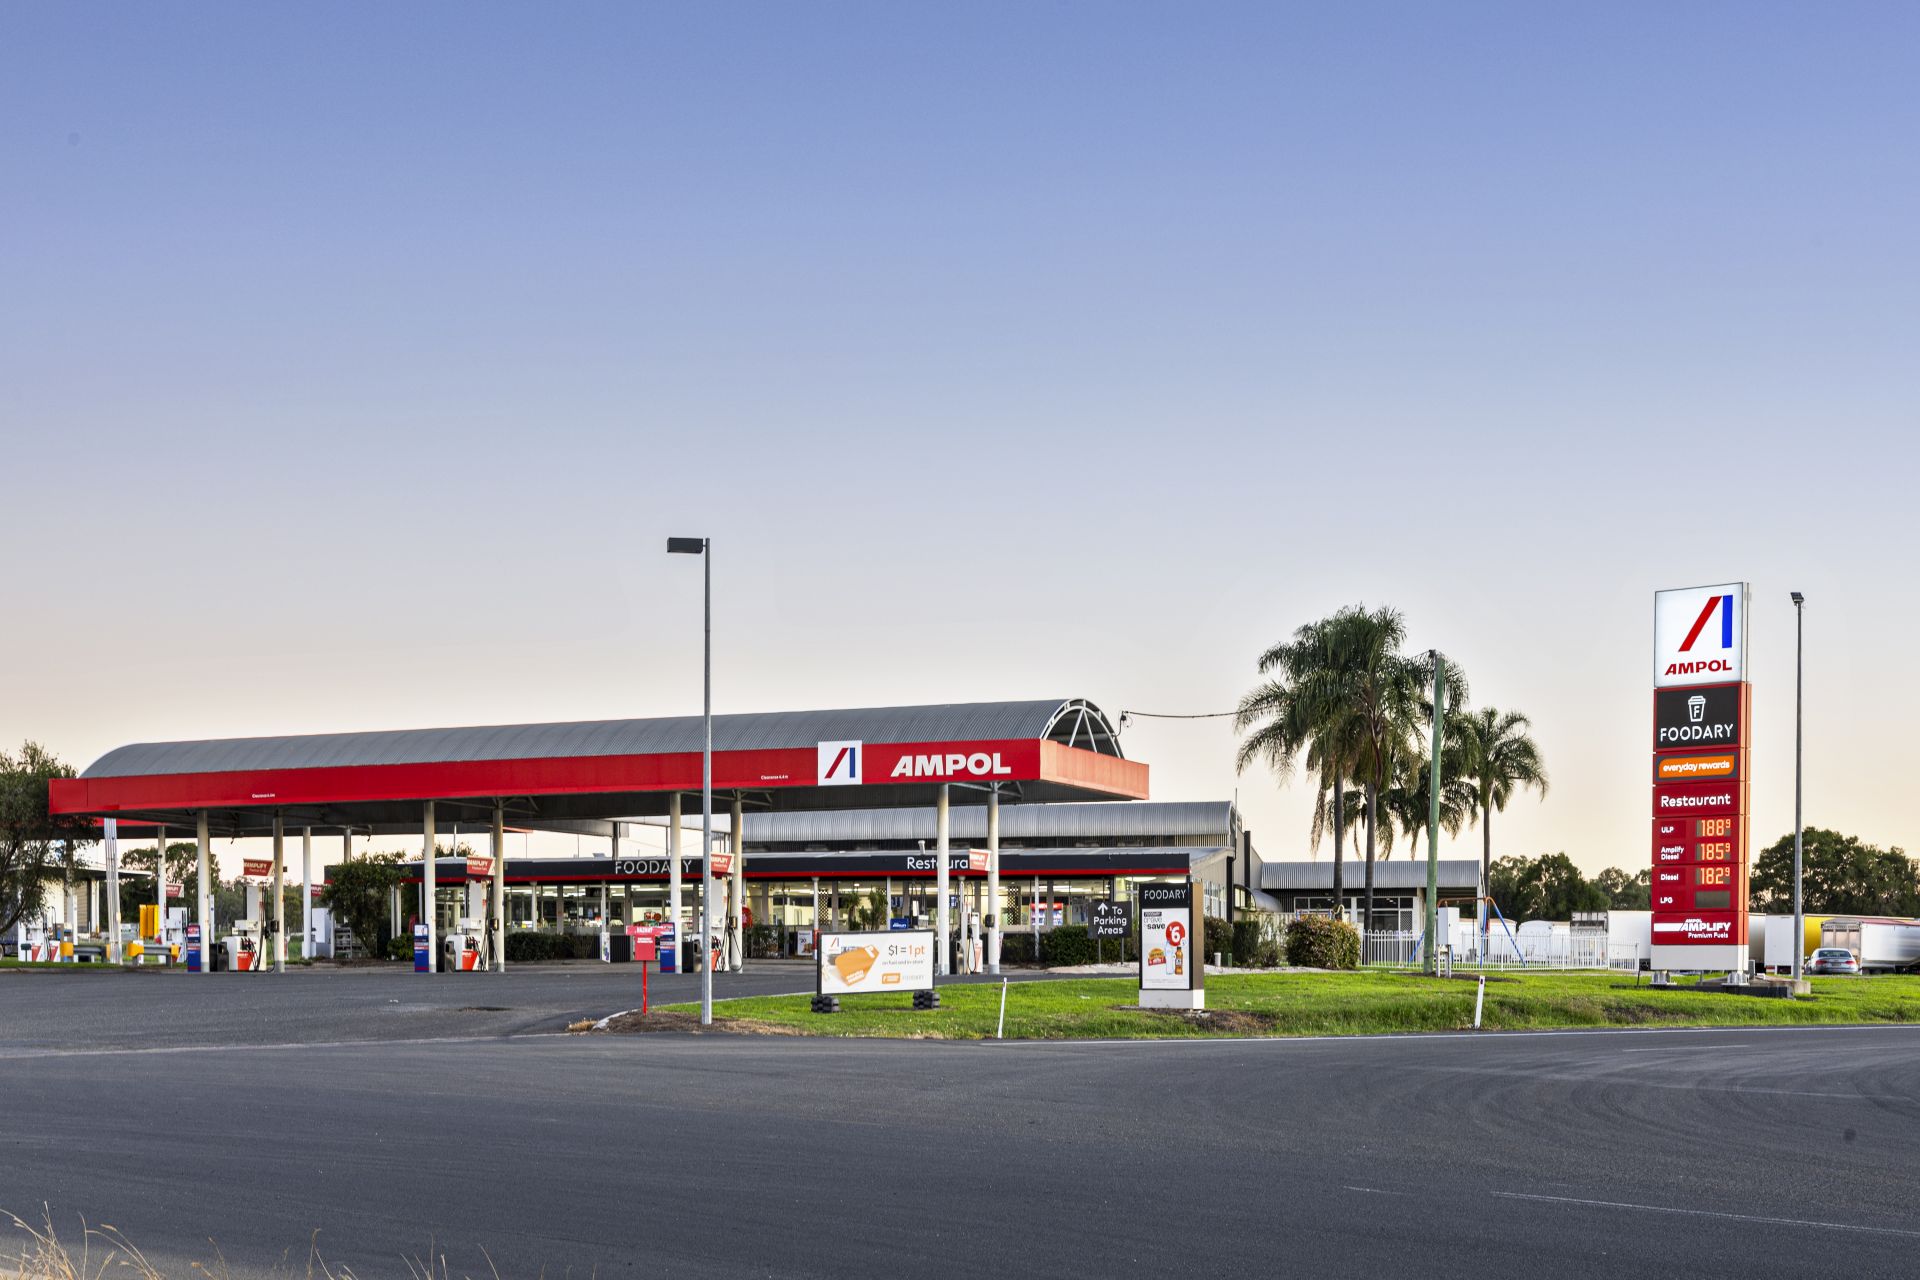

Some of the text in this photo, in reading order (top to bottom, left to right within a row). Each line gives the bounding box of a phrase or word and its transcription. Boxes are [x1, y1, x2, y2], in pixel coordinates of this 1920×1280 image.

[1664, 659, 1733, 676] AMPOL
[1693, 705, 1701, 718] F
[1660, 723, 1734, 742] FOODARY
[890, 752, 1012, 777] AMPOL
[1662, 760, 1730, 773] everyday rewards
[1661, 793, 1731, 807] Restaurant
[1661, 846, 1684, 854] Amplify
[615, 860, 692, 875] FOODAY
[1144, 889, 1187, 900] FOODARY
[1660, 896, 1673, 904] LPG
[1111, 906, 1123, 915] To
[1093, 915, 1127, 927] Parking
[1680, 922, 1731, 932] AMPLIFY
[1097, 926, 1124, 935] Areas
[888, 944, 898, 956] $1
